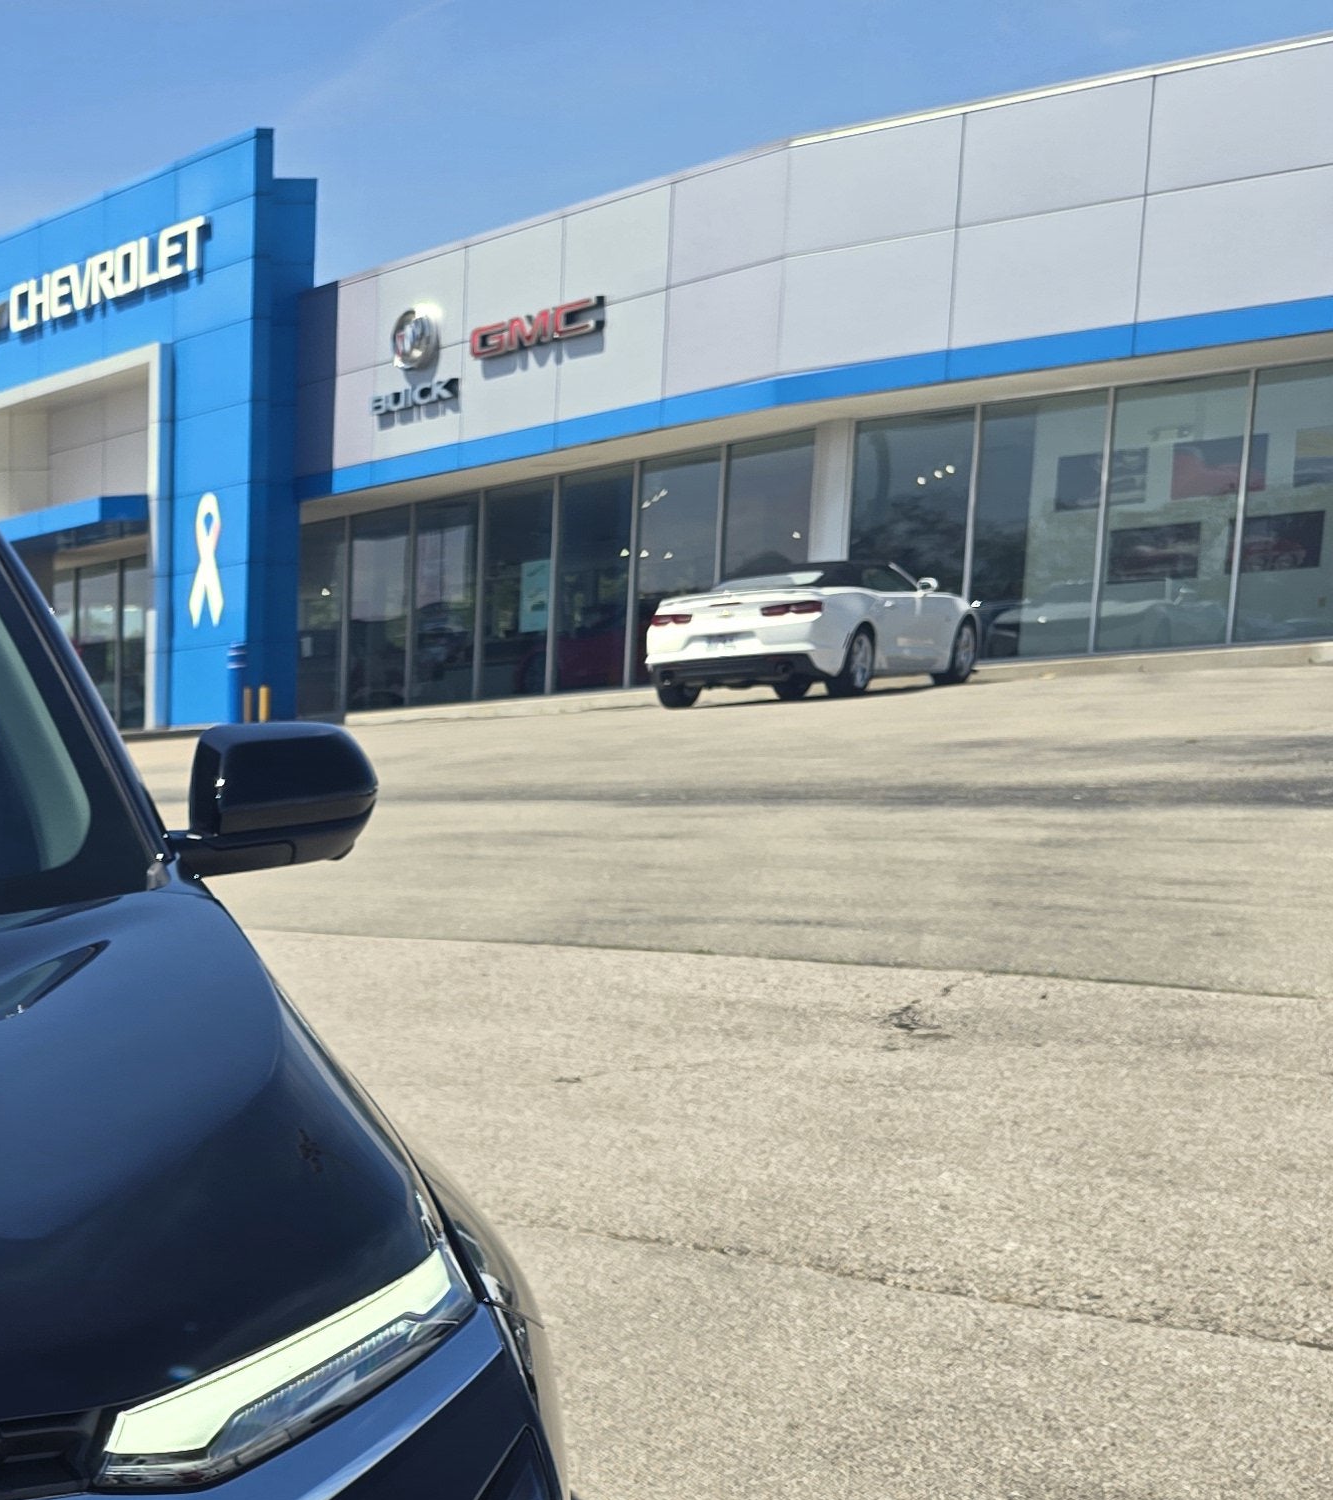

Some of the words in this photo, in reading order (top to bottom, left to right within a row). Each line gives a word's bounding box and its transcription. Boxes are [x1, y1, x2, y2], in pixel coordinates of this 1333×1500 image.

[9, 215, 205, 333] CHEVROLET
[469, 297, 601, 360] GMC
[371, 378, 458, 415] BUICK
